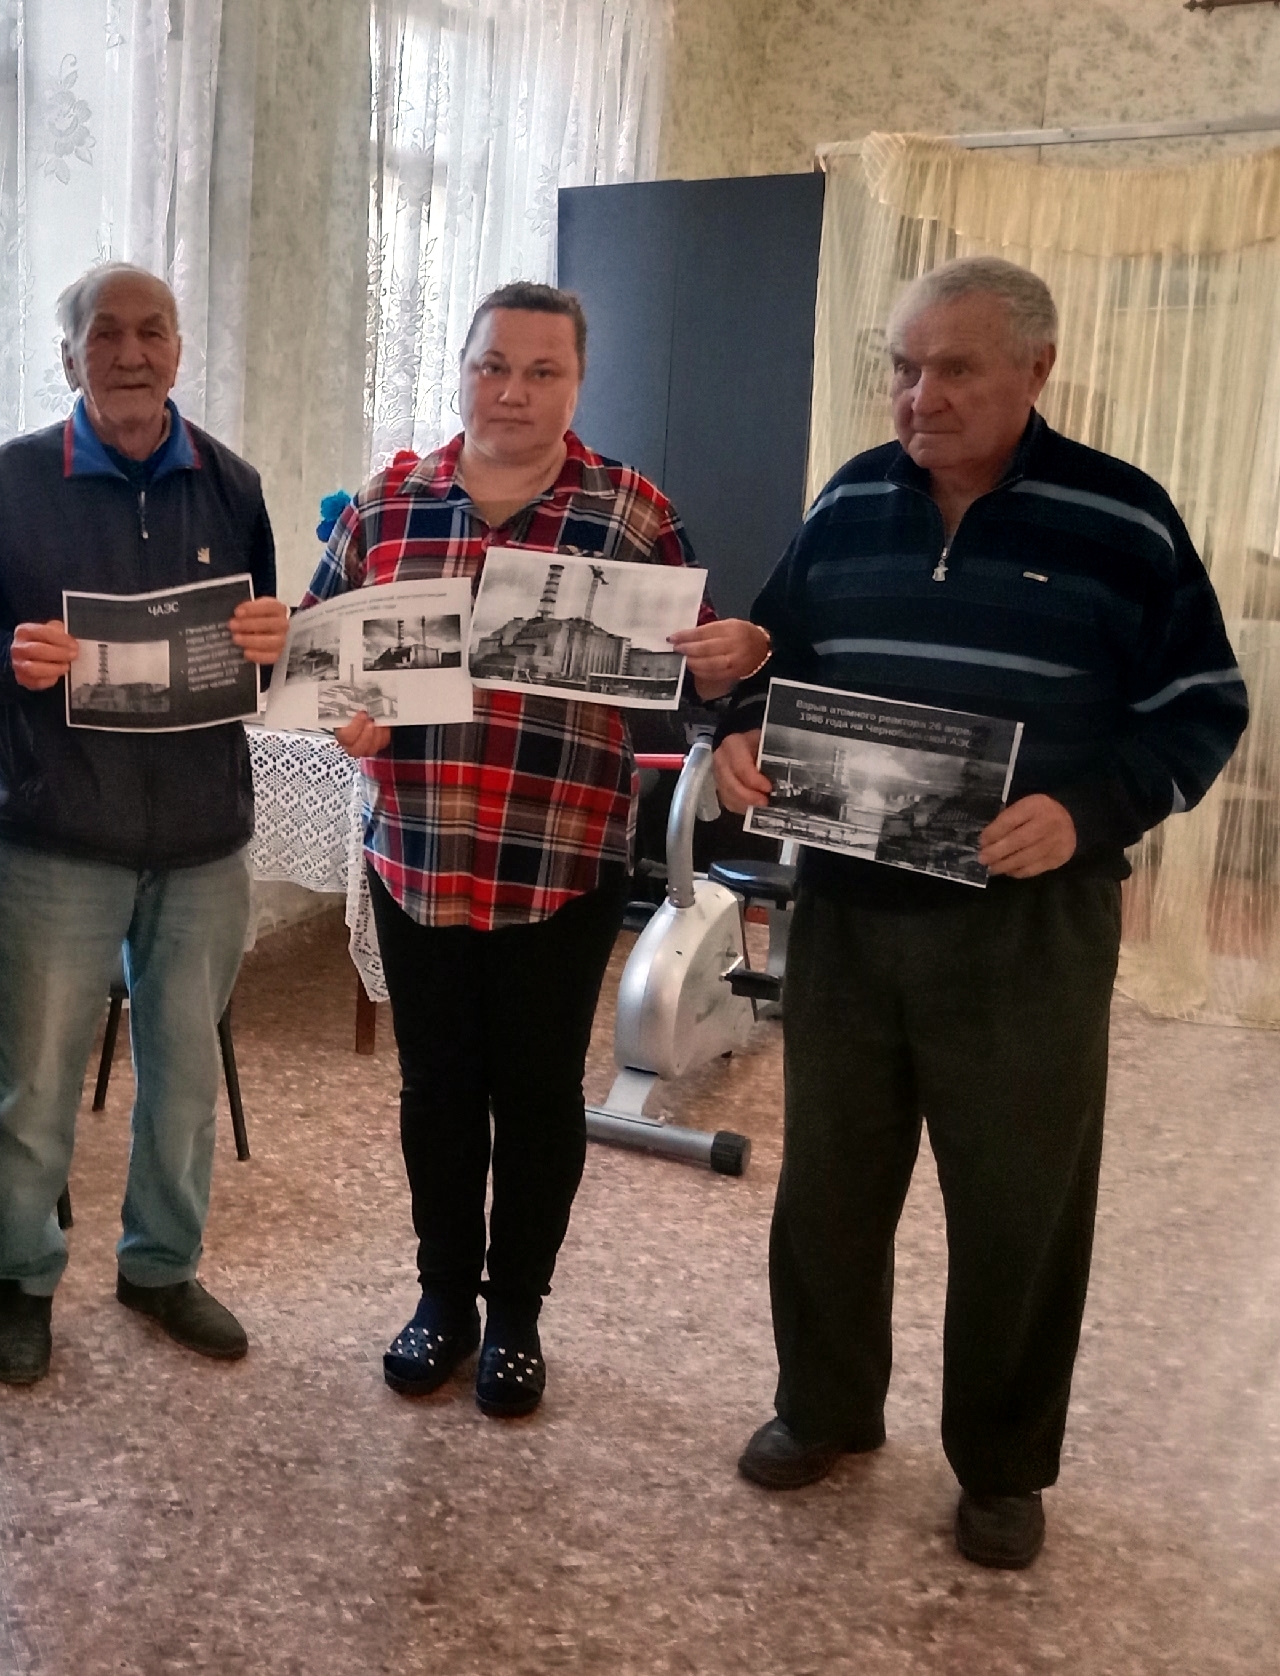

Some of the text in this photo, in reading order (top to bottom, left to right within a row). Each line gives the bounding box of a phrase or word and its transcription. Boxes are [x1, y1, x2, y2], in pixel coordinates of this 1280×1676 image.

[147, 601, 179, 617] ЧАЭС
[796, 699, 827, 713] Взрыв
[829, 707, 877, 721] атомного
[878, 715, 927, 729] реактора
[928, 721, 942, 731] 26
[800, 712, 824, 724] 1986
[825, 717, 848, 729] года
[850, 723, 863, 731] на
